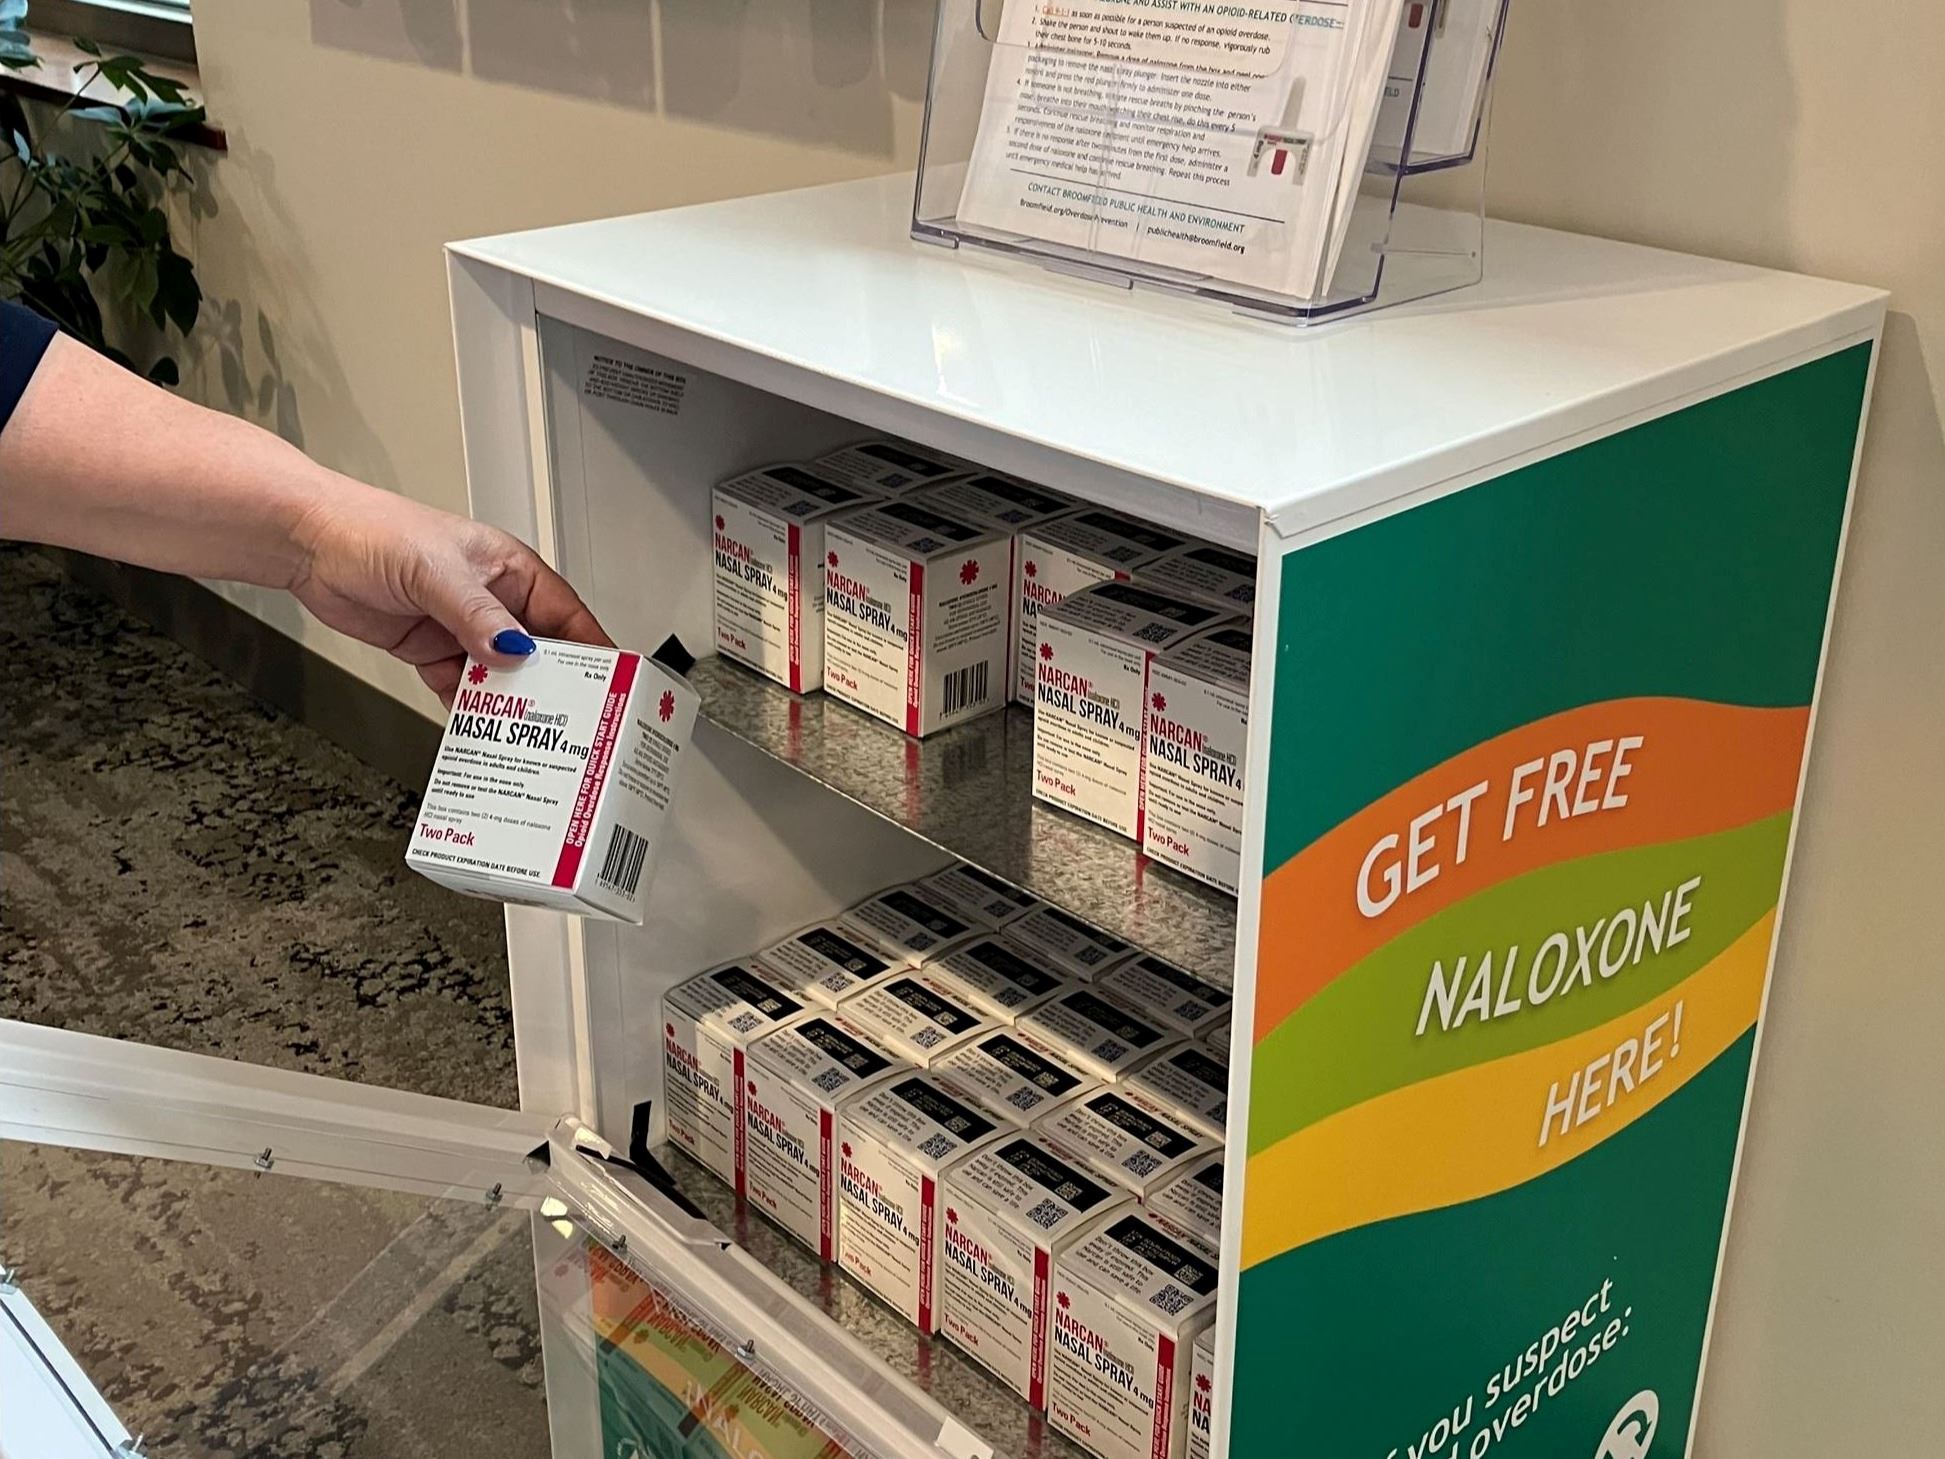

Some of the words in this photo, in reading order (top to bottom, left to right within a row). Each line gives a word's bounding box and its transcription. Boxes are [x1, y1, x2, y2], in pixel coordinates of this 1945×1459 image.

[1179, 1, 1201, 13] WITH
[1202, 4, 1215, 14] AN
[1216, 5, 1287, 23] OPIOID-RELATED
[1034, 30, 1049, 38] their
[1050, 32, 1065, 41] chest
[1067, 34, 1081, 43] bone
[1092, 38, 1106, 46] 5-10
[1039, 18, 1056, 27] Shake
[1068, 23, 1088, 32] person
[1089, 24, 1100, 32] and
[1102, 26, 1118, 34] shout
[1144, 32, 1161, 40] them
[1174, 35, 1181, 43] If
[1222, 42, 1257, 55] vigorously
[1258, 46, 1270, 55] rub
[1101, 13, 1125, 24] possible
[1126, 15, 1136, 24] for
[1142, 18, 1163, 28] person
[1164, 20, 1196, 32] suspected
[1197, 24, 1205, 32] of
[1215, 26, 1237, 37] opioid
[1237, 29, 1271, 40] overdose.
[1180, 76, 1191, 84] the
[1192, 77, 1214, 87] nozzle
[1215, 80, 1229, 89] into
[1229, 82, 1251, 92] either
[1173, 102, 1182, 111] by
[1212, 108, 1224, 116] the
[1226, 110, 1256, 122] person's
[1027, 182, 1061, 196] CONTACT
[1108, 198, 1136, 212] PUBLIC
[1137, 204, 1168, 219] HEALTH
[1169, 210, 1185, 222] AND
[1186, 214, 1245, 234] ENVIRONMENT
[1146, 225, 1246, 254] publichealth@broomfield.org
[715, 549, 742, 578] NASAL
[744, 564, 772, 592] SPRAY
[772, 584, 776, 595] 4
[777, 587, 787, 602] mg
[1023, 579, 1066, 605] NARCA
[826, 584, 857, 618] NASAL
[859, 601, 890, 634] SPRAY
[890, 625, 895, 636] 4
[896, 627, 907, 643] mg
[717, 627, 728, 642] Two
[730, 634, 745, 651] Pack
[592, 672, 606, 681] Only
[826, 665, 839, 682] Two
[840, 672, 857, 692] Pack
[602, 692, 617, 718] GUIDE
[1037, 681, 1077, 715] NASAL
[1078, 697, 1119, 732] SPRAY
[1119, 721, 1125, 734] 4
[1126, 724, 1140, 742] mg
[448, 713, 507, 742] NASAL
[504, 722, 564, 751] SPRAY
[559, 739, 568, 752] 4
[567, 744, 589, 759] mg
[594, 720, 609, 747] START
[488, 761, 505, 769] adults
[497, 754, 513, 762] Spray
[522, 758, 541, 766] known
[548, 763, 576, 773] suspected
[574, 819, 590, 847] Opioid
[582, 780, 601, 819] Overdose
[594, 740, 614, 779] Response
[606, 692, 627, 739] Instructions
[585, 748, 601, 776] QUICK
[1149, 733, 1191, 771] NASAL
[1192, 752, 1234, 790] SPRAY
[1235, 777, 1241, 791] 4
[443, 789, 458, 797] ready
[580, 776, 592, 794] FOR
[1036, 769, 1053, 786] Two
[1054, 776, 1076, 796] Pack
[542, 797, 558, 806] Spray
[573, 795, 587, 818] HERE
[417, 823, 444, 839] Two
[443, 827, 476, 845] Pack
[565, 819, 580, 844] OPEN
[1356, 780, 1488, 918] GET
[1503, 736, 1644, 841] FREE
[1147, 826, 1165, 846] Two
[1166, 835, 1189, 857] Pack
[411, 848, 429, 856] CHECK
[429, 851, 455, 861] PRODUCT
[456, 856, 490, 868] EXPIRATION
[490, 862, 505, 871] DATE
[506, 865, 527, 875] BEFORE
[1416, 877, 1701, 1035] NALOXONE
[666, 1051, 692, 1083] NASAL
[693, 1071, 718, 1102] SPRAY
[1538, 1000, 1683, 1148] HERE!
[681, 1127, 694, 1146] Pack
[747, 1108, 774, 1146] NASAL
[776, 1130, 804, 1167] SPRAY
[808, 1161, 819, 1179] mg
[749, 1178, 760, 1197] Two
[762, 1189, 776, 1210] Pack
[840, 1172, 871, 1210] NASAL
[872, 1195, 902, 1233] SPRAY
[902, 1225, 907, 1236] 4
[908, 1229, 919, 1248] mg
[855, 1255, 870, 1276] Pack
[944, 1238, 978, 1279] NASAL
[980, 1265, 1014, 1304] SPRAY
[1014, 1296, 1018, 1308] 4
[1019, 1300, 1032, 1320] mg
[944, 1312, 958, 1332] Two
[960, 1324, 978, 1348] Pack
[1053, 1324, 1093, 1365] NASAL
[1094, 1352, 1133, 1392] SPRAY
[1132, 1385, 1138, 1397] 4
[1139, 1389, 1153, 1408] mg
[1408, 1395, 1472, 1459] you
[1485, 1278, 1613, 1408] suspect
[1470, 1306, 1632, 1459] overdose:
[1051, 1401, 1068, 1421] Two
[1069, 1413, 1090, 1436] Pack
